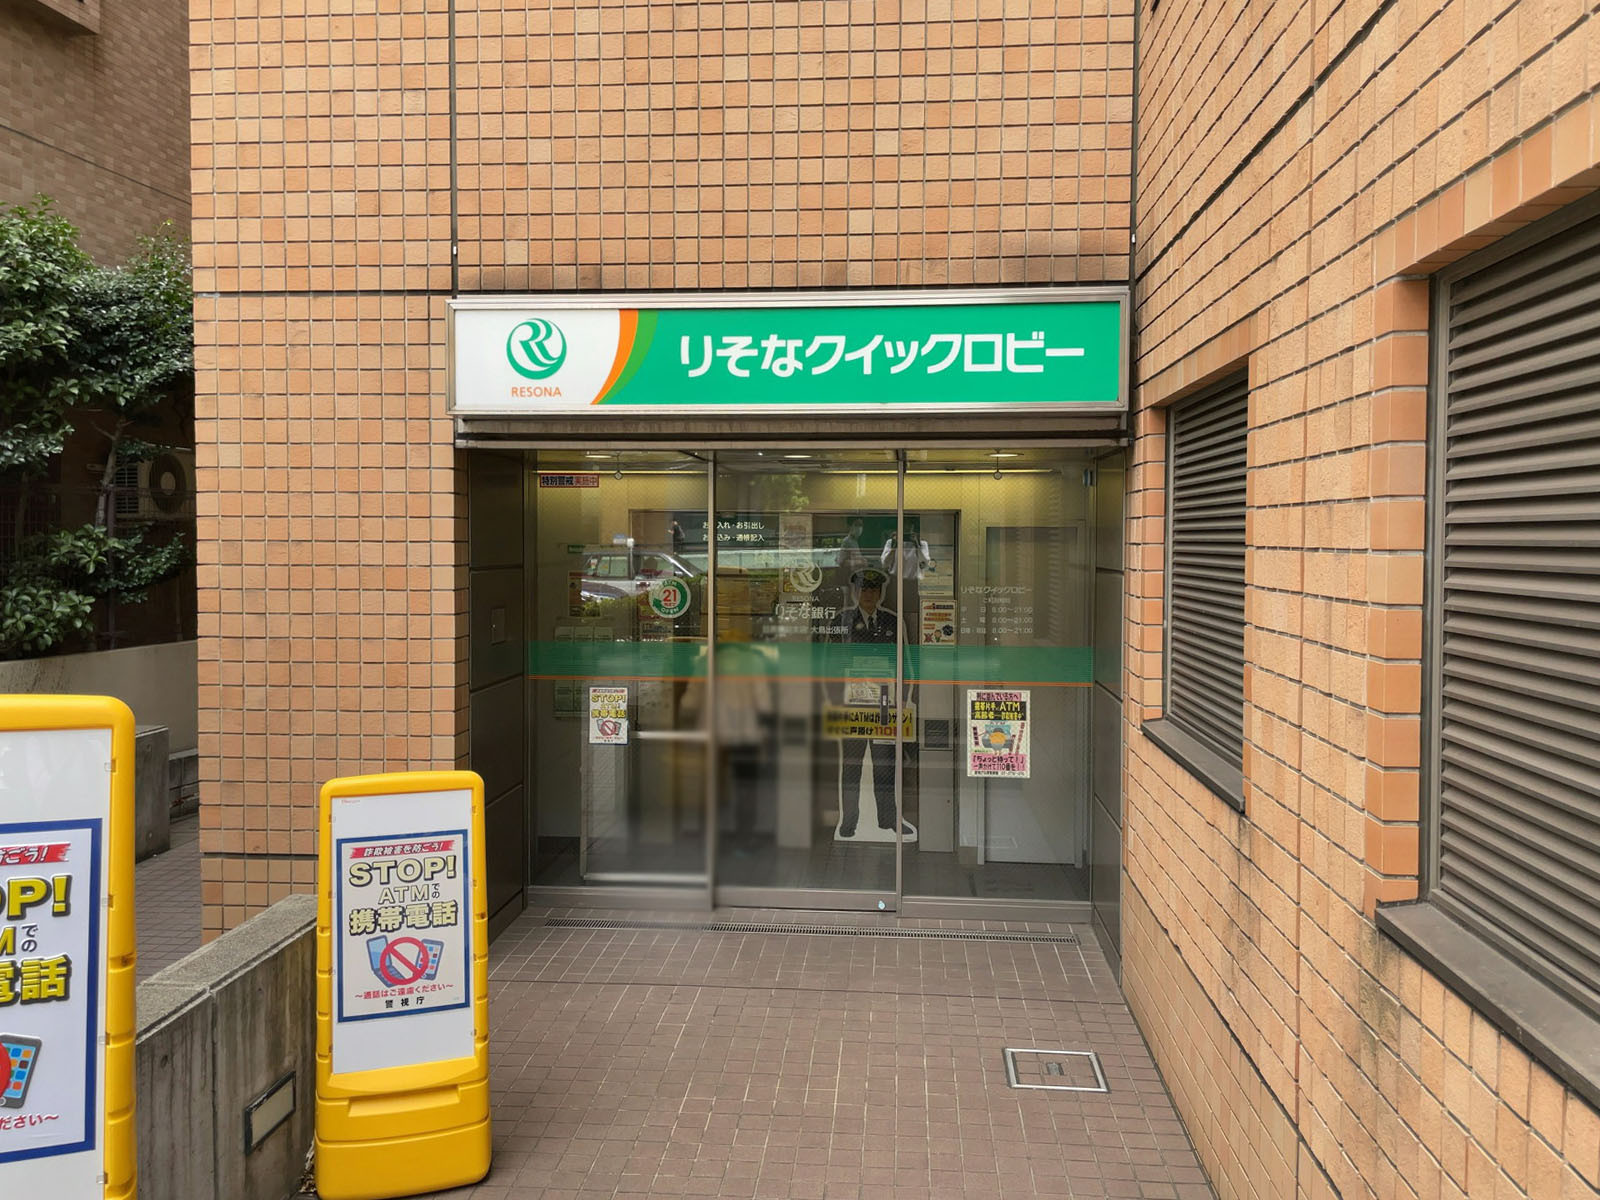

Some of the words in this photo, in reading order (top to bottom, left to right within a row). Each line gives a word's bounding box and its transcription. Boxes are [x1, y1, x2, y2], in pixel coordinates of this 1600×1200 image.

[680, 331, 1086, 378] りそなクイックロビー
[511, 387, 562, 398] RESONA
[702, 521, 765, 530] お入れ・お引出し
[702, 533, 765, 542] お込み・通帳記入
[663, 589, 678, 602] 21
[775, 603, 837, 620] りそな銀行
[591, 694, 627, 703] STOP!
[363, 842, 444, 858] 詐欺被害を防ごう!
[349, 854, 457, 888] STOP!
[0, 875, 72, 921] P!
[349, 899, 459, 936] 携帯電話
